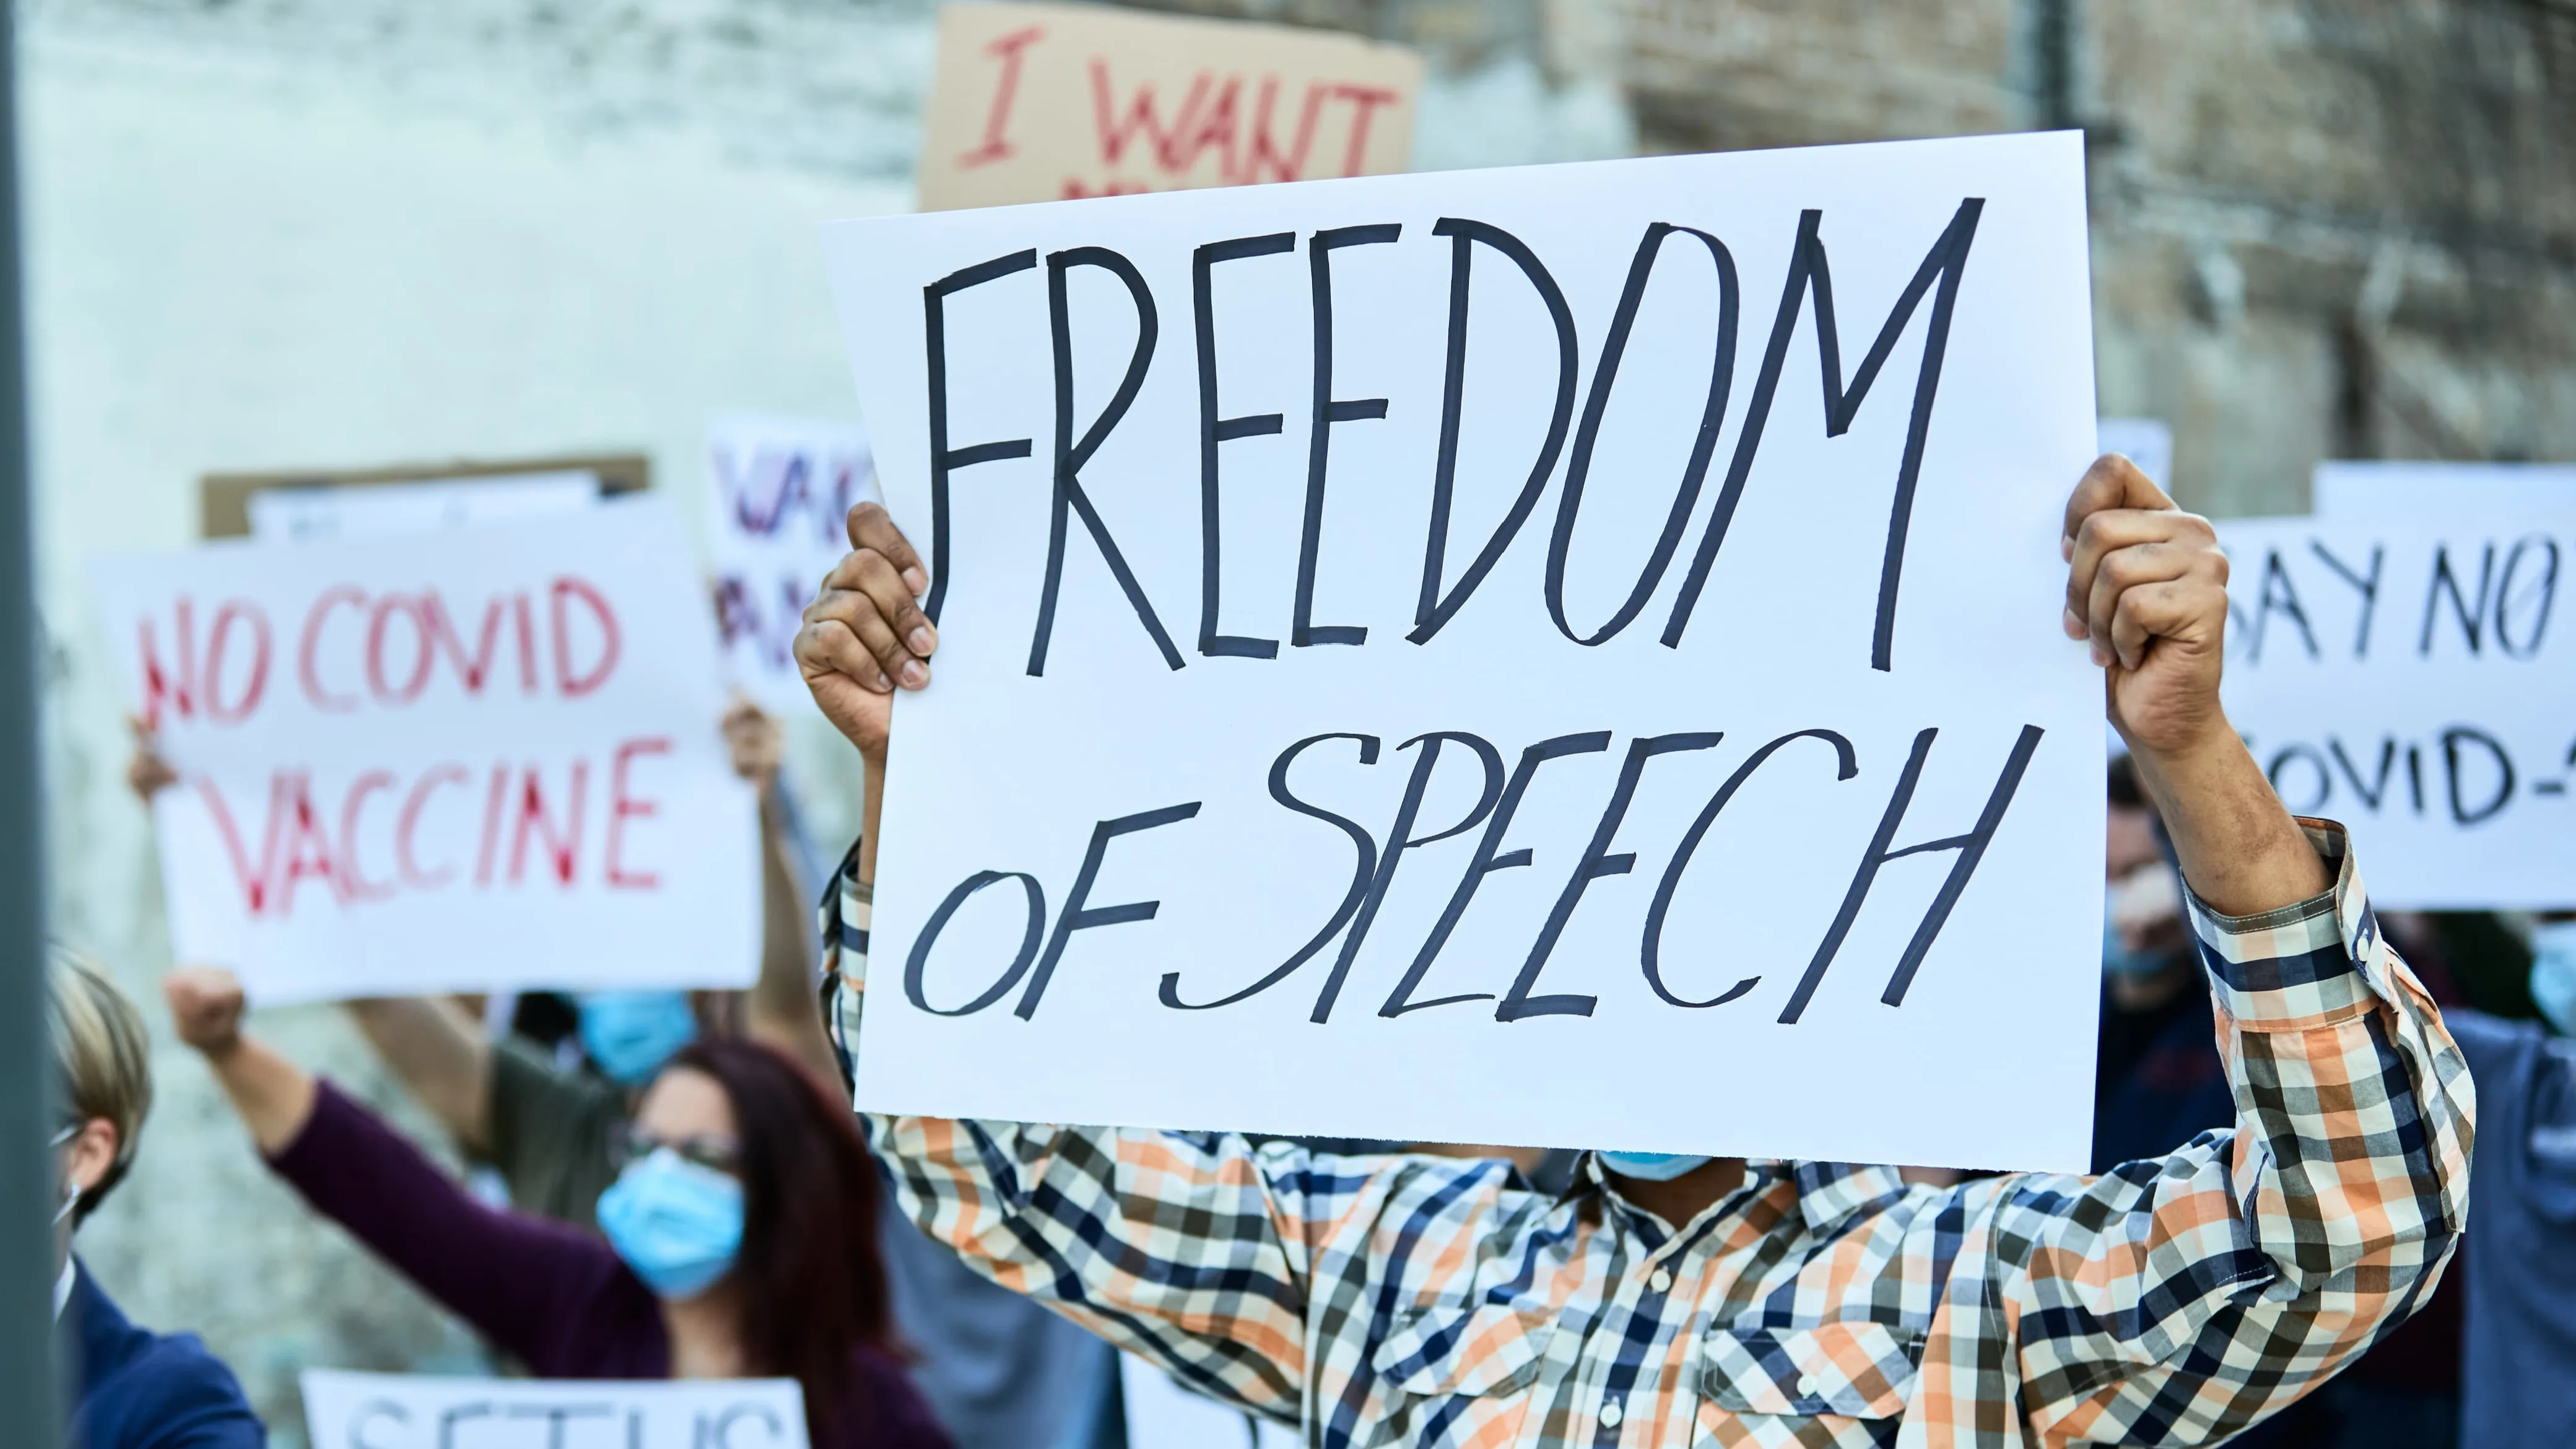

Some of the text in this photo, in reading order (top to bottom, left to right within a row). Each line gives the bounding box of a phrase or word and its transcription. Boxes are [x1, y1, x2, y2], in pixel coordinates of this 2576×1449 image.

[957, 22, 1400, 186] I WANT
[923, 198, 1985, 676] FREEDOM
[136, 591, 272, 732] NO
[297, 573, 623, 712] COVID
[2418, 531, 2561, 663] NO
[198, 734, 675, 918] VACCINE
[903, 724, 2045, 1025] OF SPEECH
